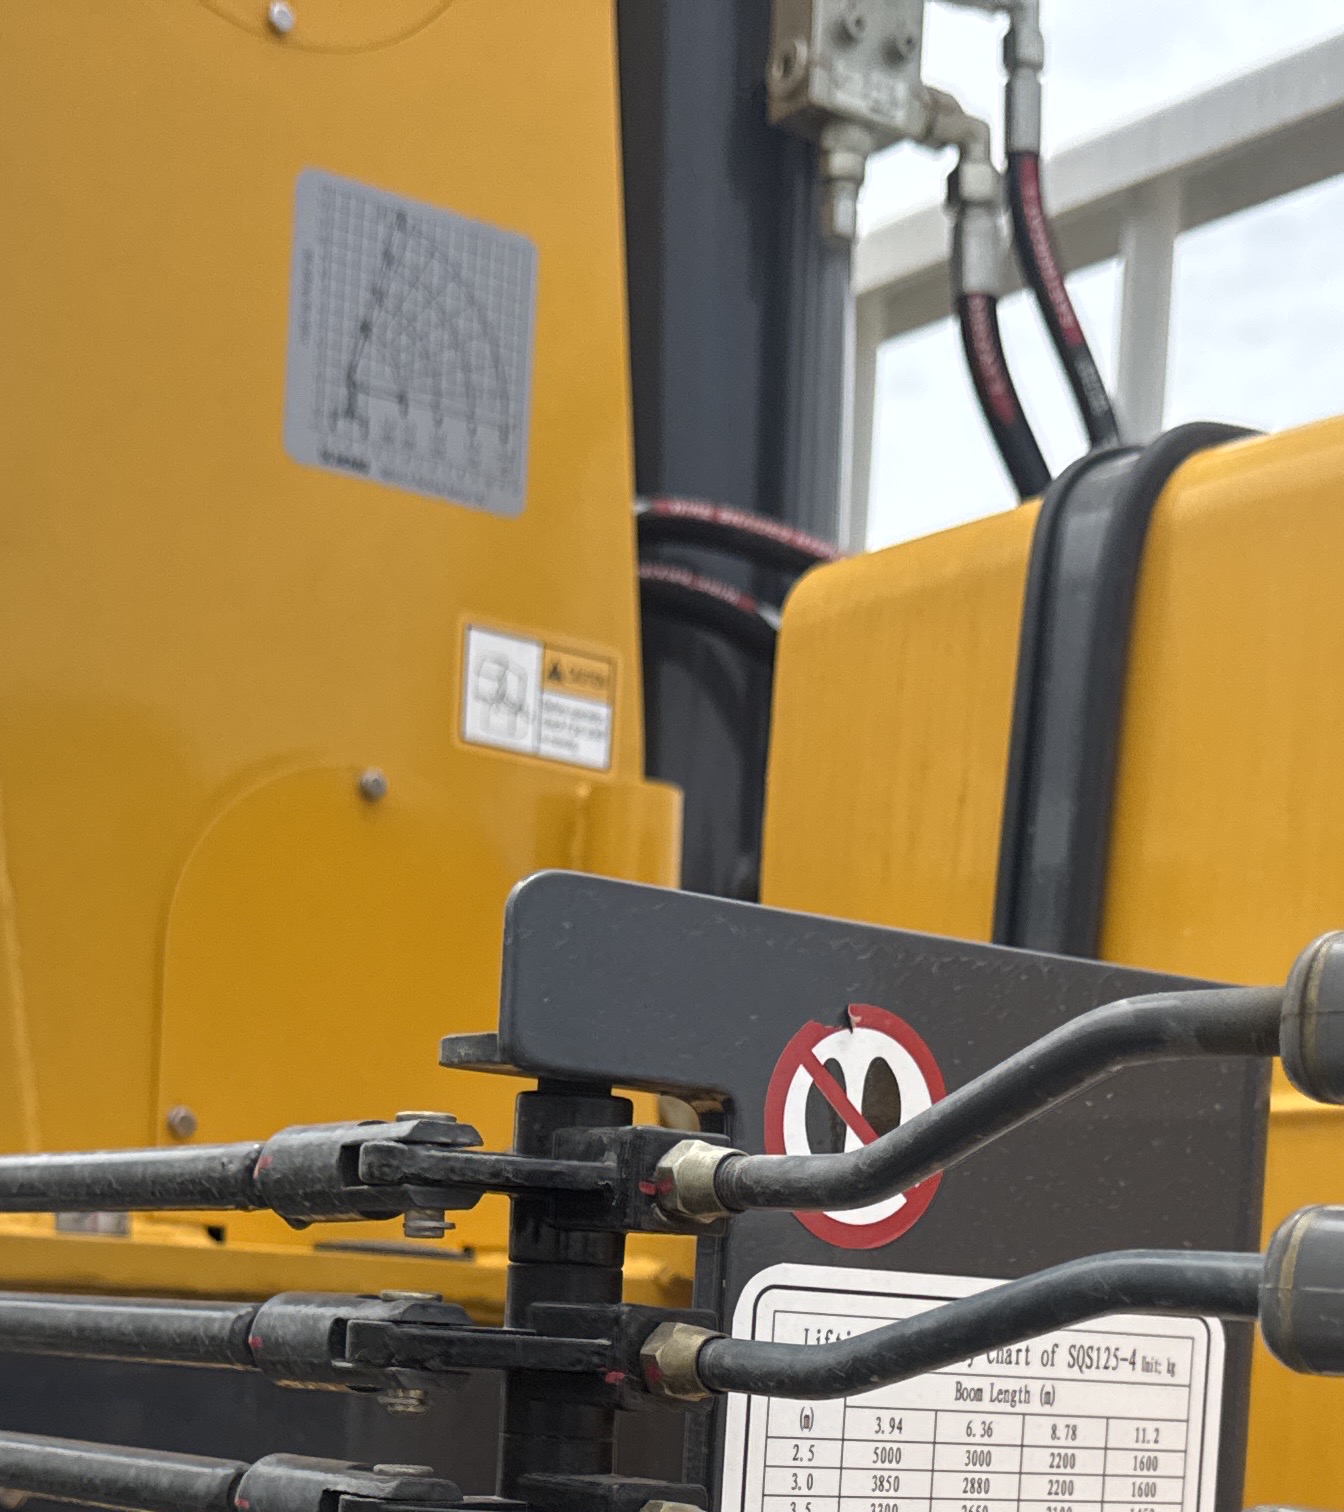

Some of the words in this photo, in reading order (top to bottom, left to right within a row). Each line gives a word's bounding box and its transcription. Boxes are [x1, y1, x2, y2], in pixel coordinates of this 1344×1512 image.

[1041, 1343, 1058, 1367] of
[1067, 1344, 1137, 1374] SQS125-4
[955, 1381, 983, 1402] Boom
[989, 1382, 1031, 1408] Length
[1040, 1384, 1056, 1407] (m)
[799, 1406, 815, 1432] (m)
[875, 1417, 903, 1434] 3.94
[966, 1420, 994, 1438] 6.36
[1051, 1424, 1077, 1441] 8.78
[1135, 1427, 1160, 1445] 11.2
[792, 1444, 815, 1462] 2.5
[872, 1447, 902, 1464] 5000
[964, 1450, 992, 1467] 3000
[1049, 1453, 1076, 1470] 2200
[1133, 1455, 1158, 1472] 1600
[791, 1473, 814, 1491] 3.0
[871, 1475, 900, 1492] 3850
[962, 1477, 990, 1494] 2880
[1047, 1479, 1074, 1496] 2200
[1131, 1481, 1157, 1498] 1600
